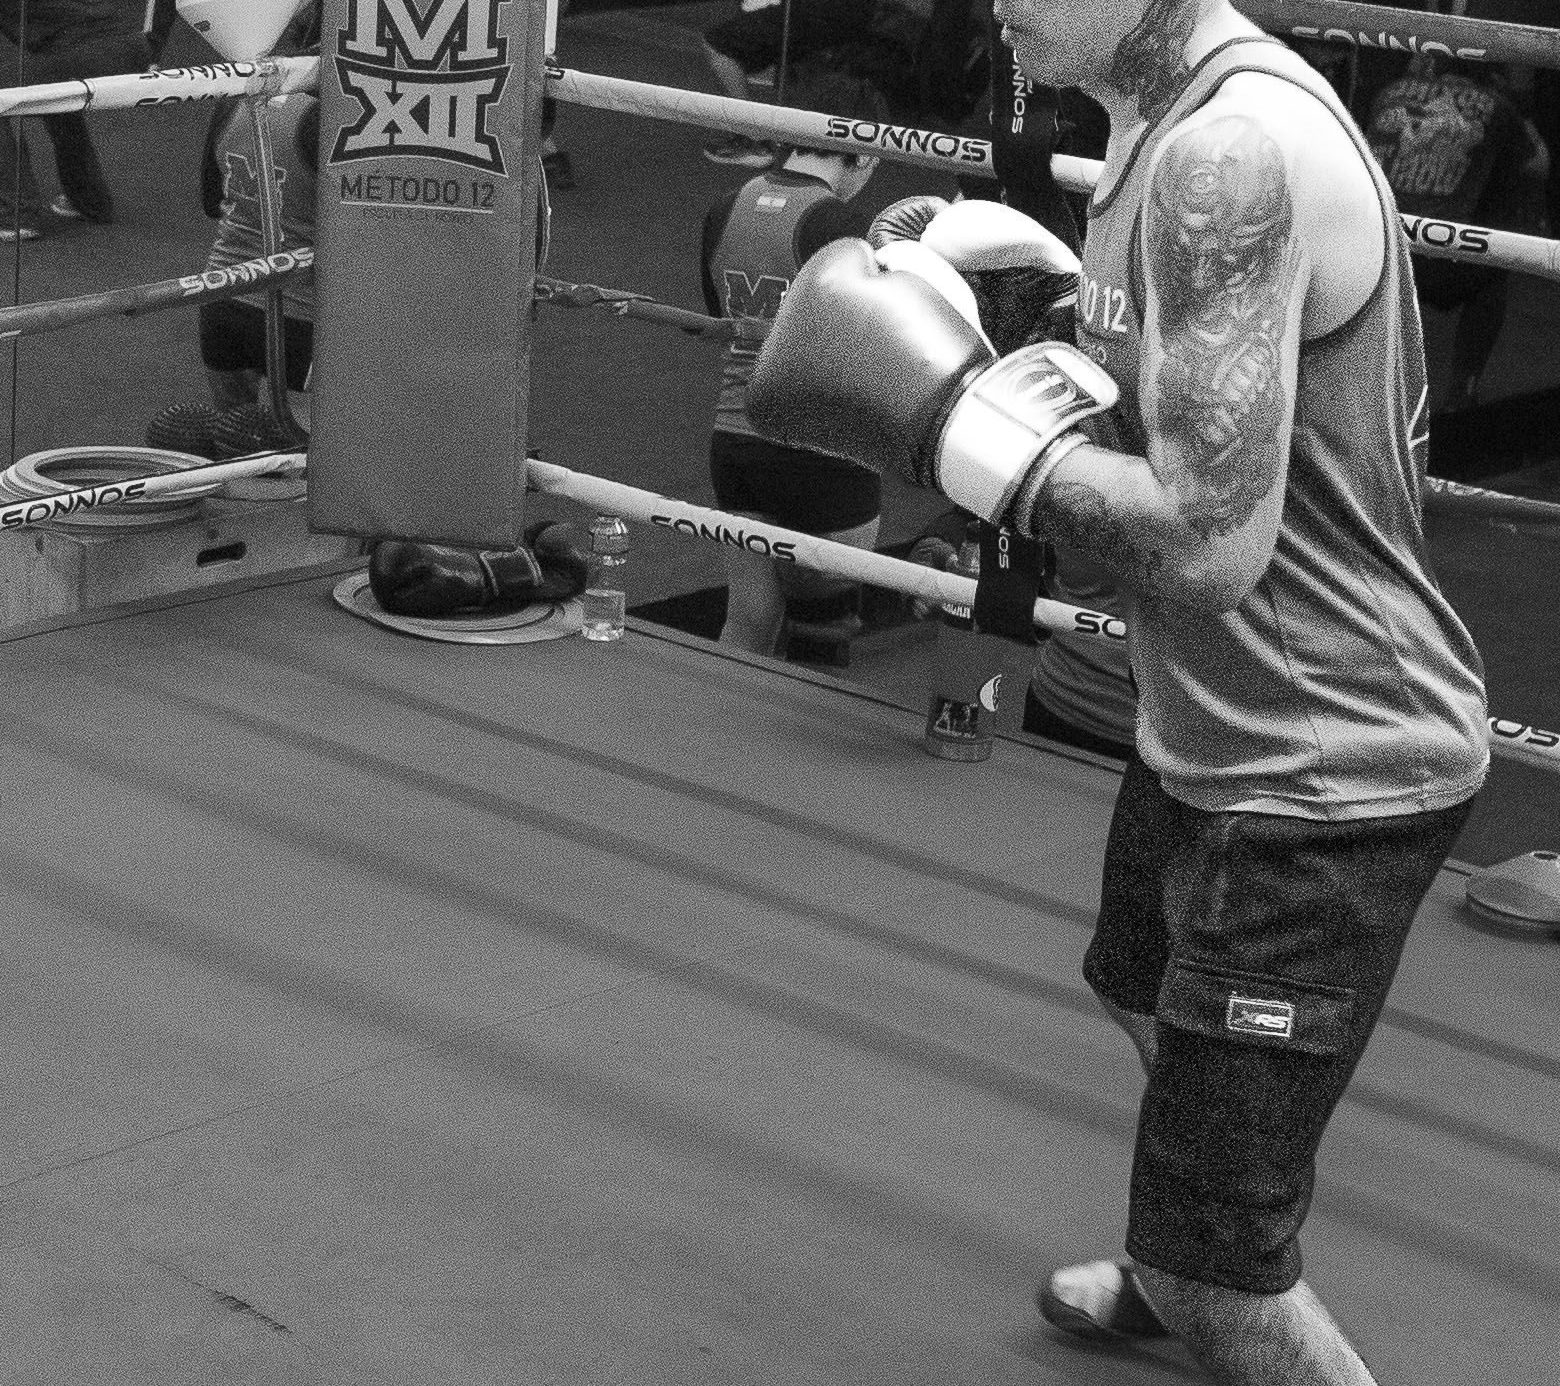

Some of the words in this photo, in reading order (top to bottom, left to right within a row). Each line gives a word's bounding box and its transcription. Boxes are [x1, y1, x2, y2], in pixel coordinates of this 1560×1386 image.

[825, 116, 989, 164] SONNOS
[340, 168, 461, 206] MÉTODO
[471, 181, 495, 208] 12
[1402, 217, 1492, 254] NOS
[1, 481, 147, 529] SONNOS
[650, 514, 797, 563] SONNOS
